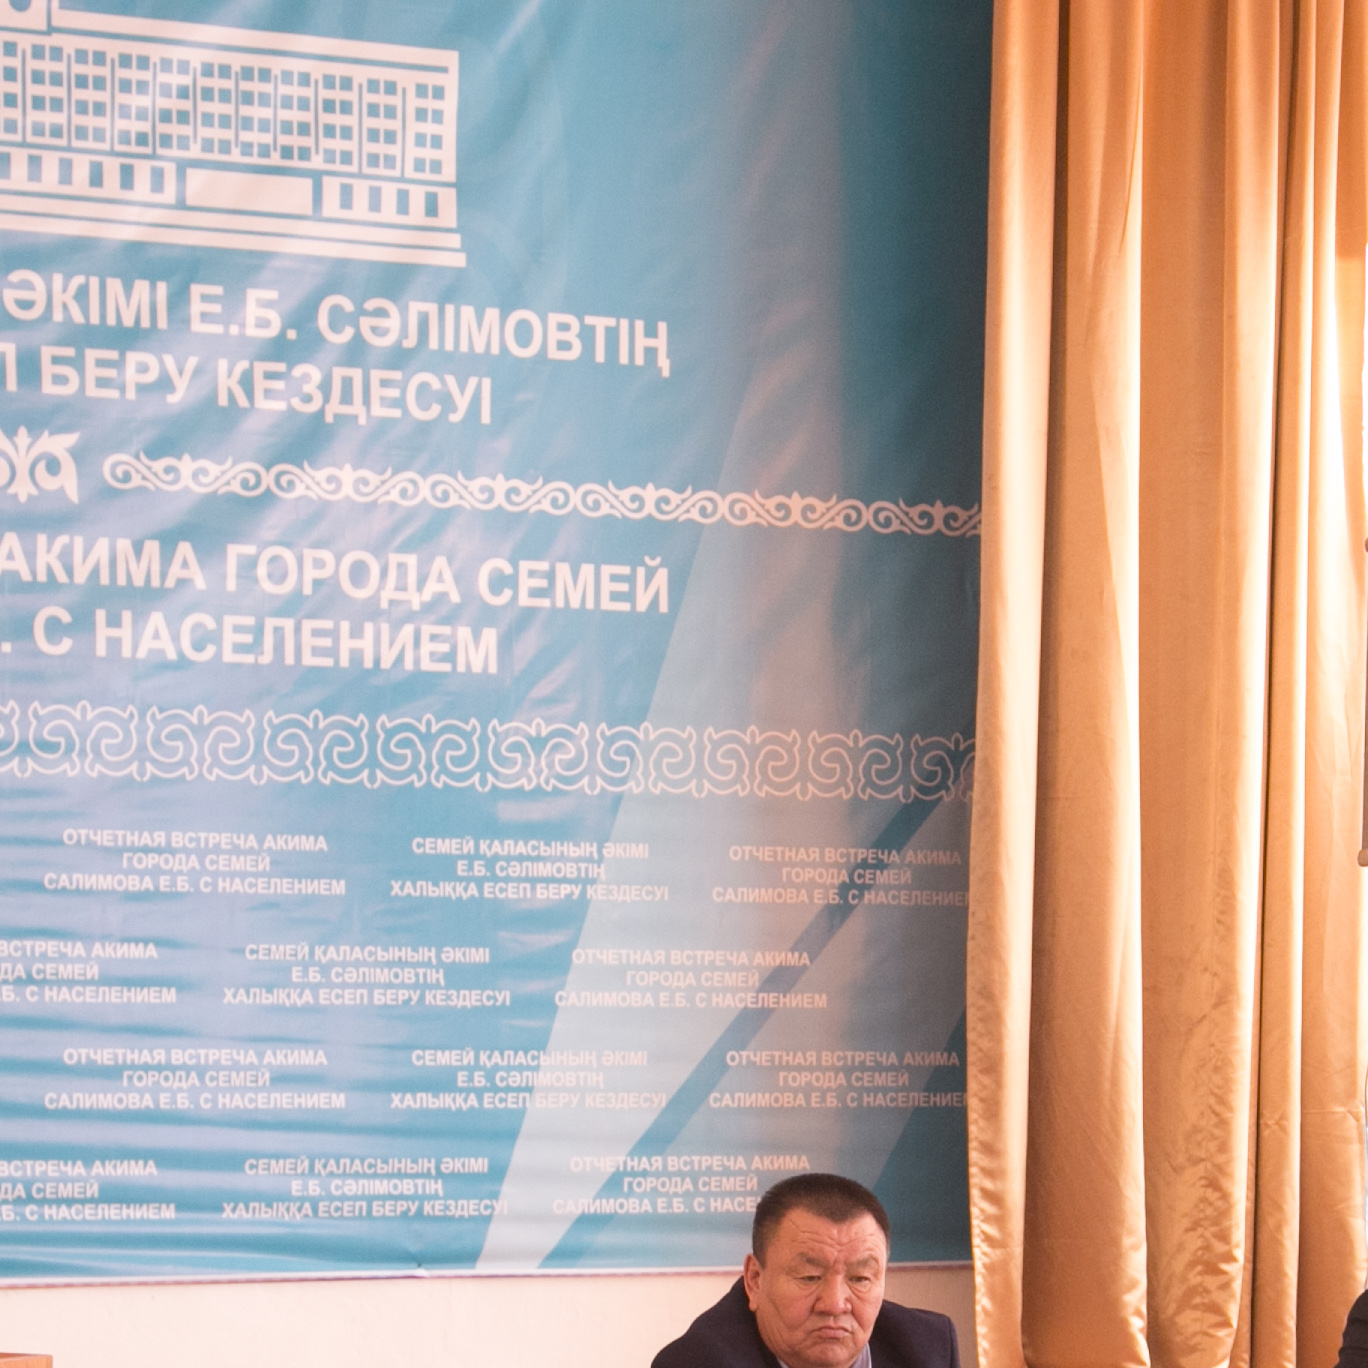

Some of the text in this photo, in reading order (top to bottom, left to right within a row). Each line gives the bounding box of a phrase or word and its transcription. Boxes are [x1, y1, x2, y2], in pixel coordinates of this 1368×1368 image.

[1, 270, 167, 328] ӘКІМІ
[191, 285, 297, 340] Е.Б.
[316, 296, 670, 373] СӘЛІМОВТІҢ
[40, 345, 195, 409] БЕРУ
[217, 356, 491, 426] КЕЗДЕСУІ
[226, 535, 460, 608] ГОРОДА
[477, 558, 668, 612] СЕМЕЙ
[33, 596, 72, 656] С
[95, 611, 497, 672] НАСЕЛЕНИЕМ
[63, 828, 328, 851] ОТЧЕТНАЯ ВСТРЕЧА АКИМА
[412, 834, 477, 856] СЕМЕЙ
[122, 851, 271, 875] ГОРОДА СЕМЕЙ
[729, 844, 962, 866] ОТЧЕТНАЯ ВСТРЕЧА АКИМА
[457, 860, 491, 878] Е.Б.
[782, 864, 912, 888] ГОРОДА СЕМЕЙ
[44, 872, 346, 896] САЛИМОВА Е.Б. С НАСЕЛЕНИЕМ
[485, 882, 532, 901] ЕСЕП
[537, 883, 582, 901] БЕРУ
[712, 886, 969, 907] САЛИМОВА Е.Б. С НАСЕЛЕНИЕ
[90, 940, 158, 959] АКИМА
[246, 940, 490, 967] СЕМЕЙ ҚАЛАСЫНЫҢ ӘКІМІ
[572, 948, 811, 967] ОТЧЕТНАЯ ВСТРЕЧА АКИМА
[32, 958, 99, 980] СЕМЕЙ
[291, 966, 445, 988] Е.Б. СӘЛІМОВТІҢ
[626, 966, 759, 991] ГОРОДА СЕМЕЙ
[25, 985, 39, 1003] С
[45, 985, 176, 1003] НАСЕЛЕНИЕМ
[223, 987, 510, 1011] ХАЛЫҚҚА ЕСЕП БЕРУ КЕЗДЕСУІ
[554, 990, 827, 1010] САЛИМОВА Е.Б. С НАСЕЛЕНИЕМ
[63, 1046, 328, 1066] ОТЧЕТНАЯ ВСТРЕЧА АКИМА
[412, 1045, 476, 1067] СЕМЕЙ
[123, 1067, 271, 1092] ГОРОДА СЕМЕЙ
[457, 1070, 491, 1088] Е.Б.
[44, 1092, 346, 1110] САЛИМОВА Е.Б. С НАСЕЛЕНИЕМ
[484, 1092, 531, 1110] ЕСЕП
[536, 1092, 581, 1110] БЕРУ
[90, 1160, 157, 1179] АКИМА
[32, 1178, 99, 1199] СЕМЕЙ
[25, 1204, 39, 1222] С
[45, 1203, 176, 1222] НАСЕЛЕНИЕМ
